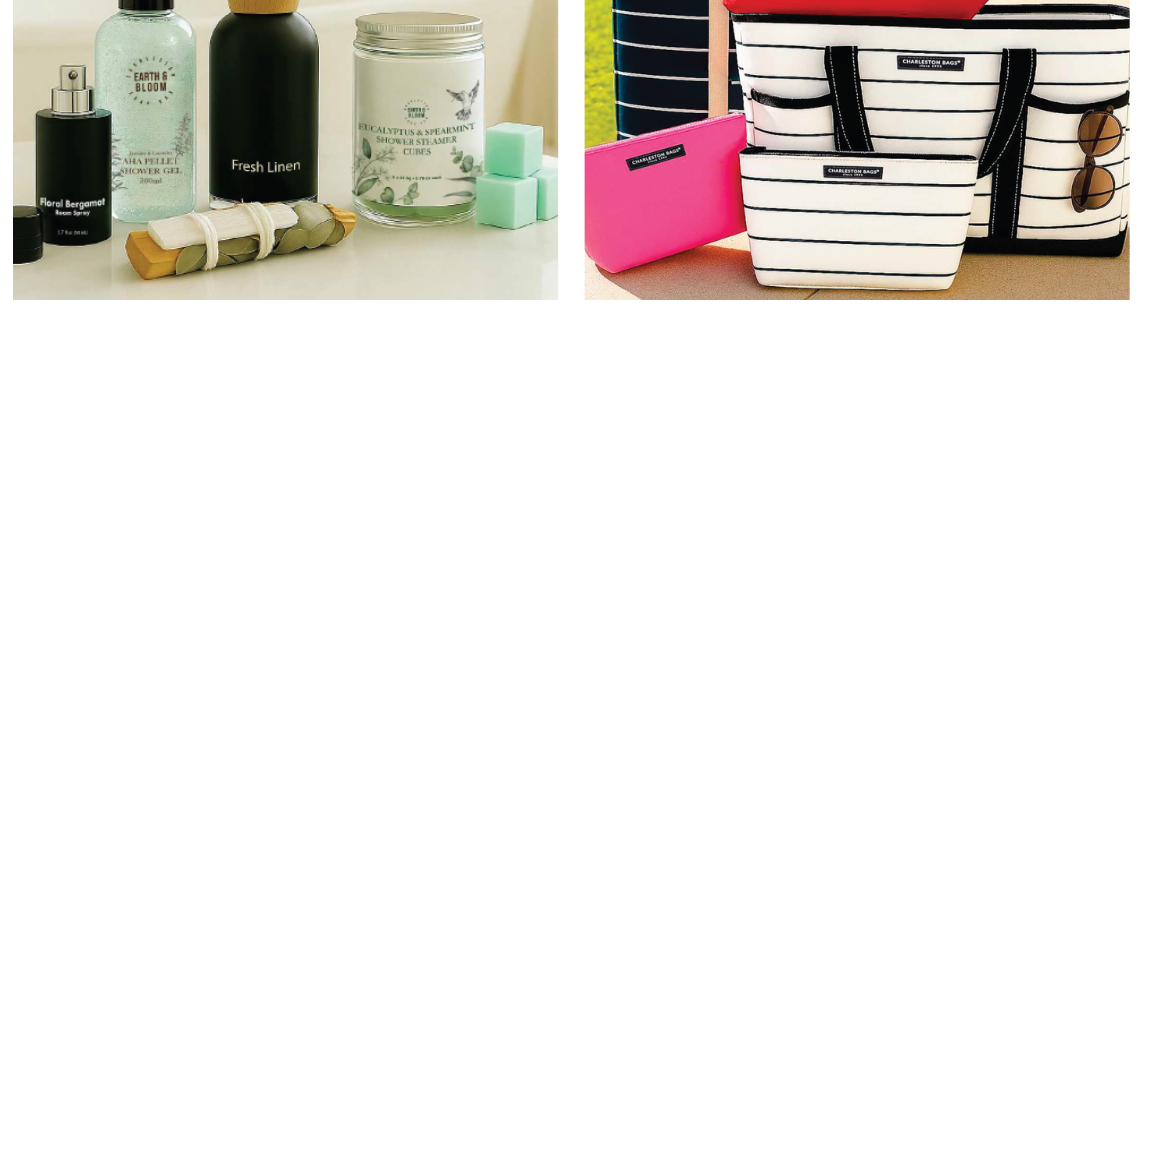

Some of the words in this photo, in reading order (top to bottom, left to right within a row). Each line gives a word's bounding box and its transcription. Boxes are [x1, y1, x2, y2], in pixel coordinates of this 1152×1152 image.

[134, 72, 160, 82] EARTH
[162, 71, 168, 81] &
[135, 82, 167, 92] BLOOM
[359, 123, 415, 136] EUCALYPTUS
[425, 122, 475, 135] SPEARMINT
[376, 136, 415, 145] SHOWER
[416, 136, 457, 145] STEAMER
[403, 148, 431, 156] CUBES
[632, 152, 665, 165] CHARLESTON
[232, 159, 264, 173] Fresh
[268, 161, 301, 173] Linen
[40, 197, 64, 208] Floral
[65, 198, 106, 210] Bergamot
